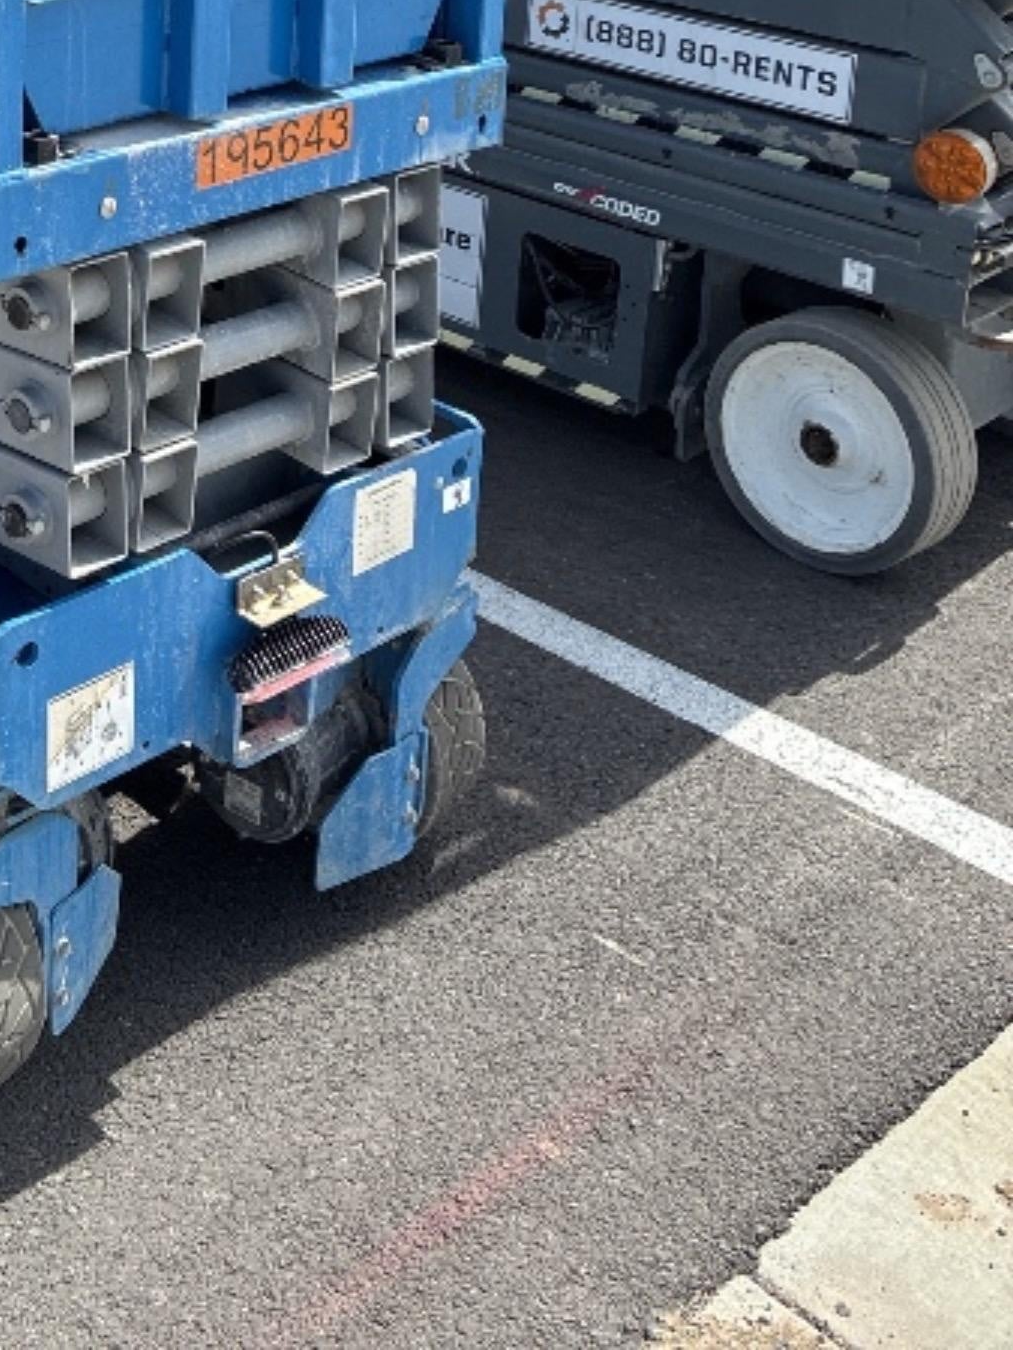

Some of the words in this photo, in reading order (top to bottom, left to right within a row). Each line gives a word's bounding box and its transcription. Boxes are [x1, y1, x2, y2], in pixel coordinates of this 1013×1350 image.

[586, 14, 667, 58] (888)
[677, 38, 837, 97] 80-RENTS
[202, 107, 349, 184] 195643
